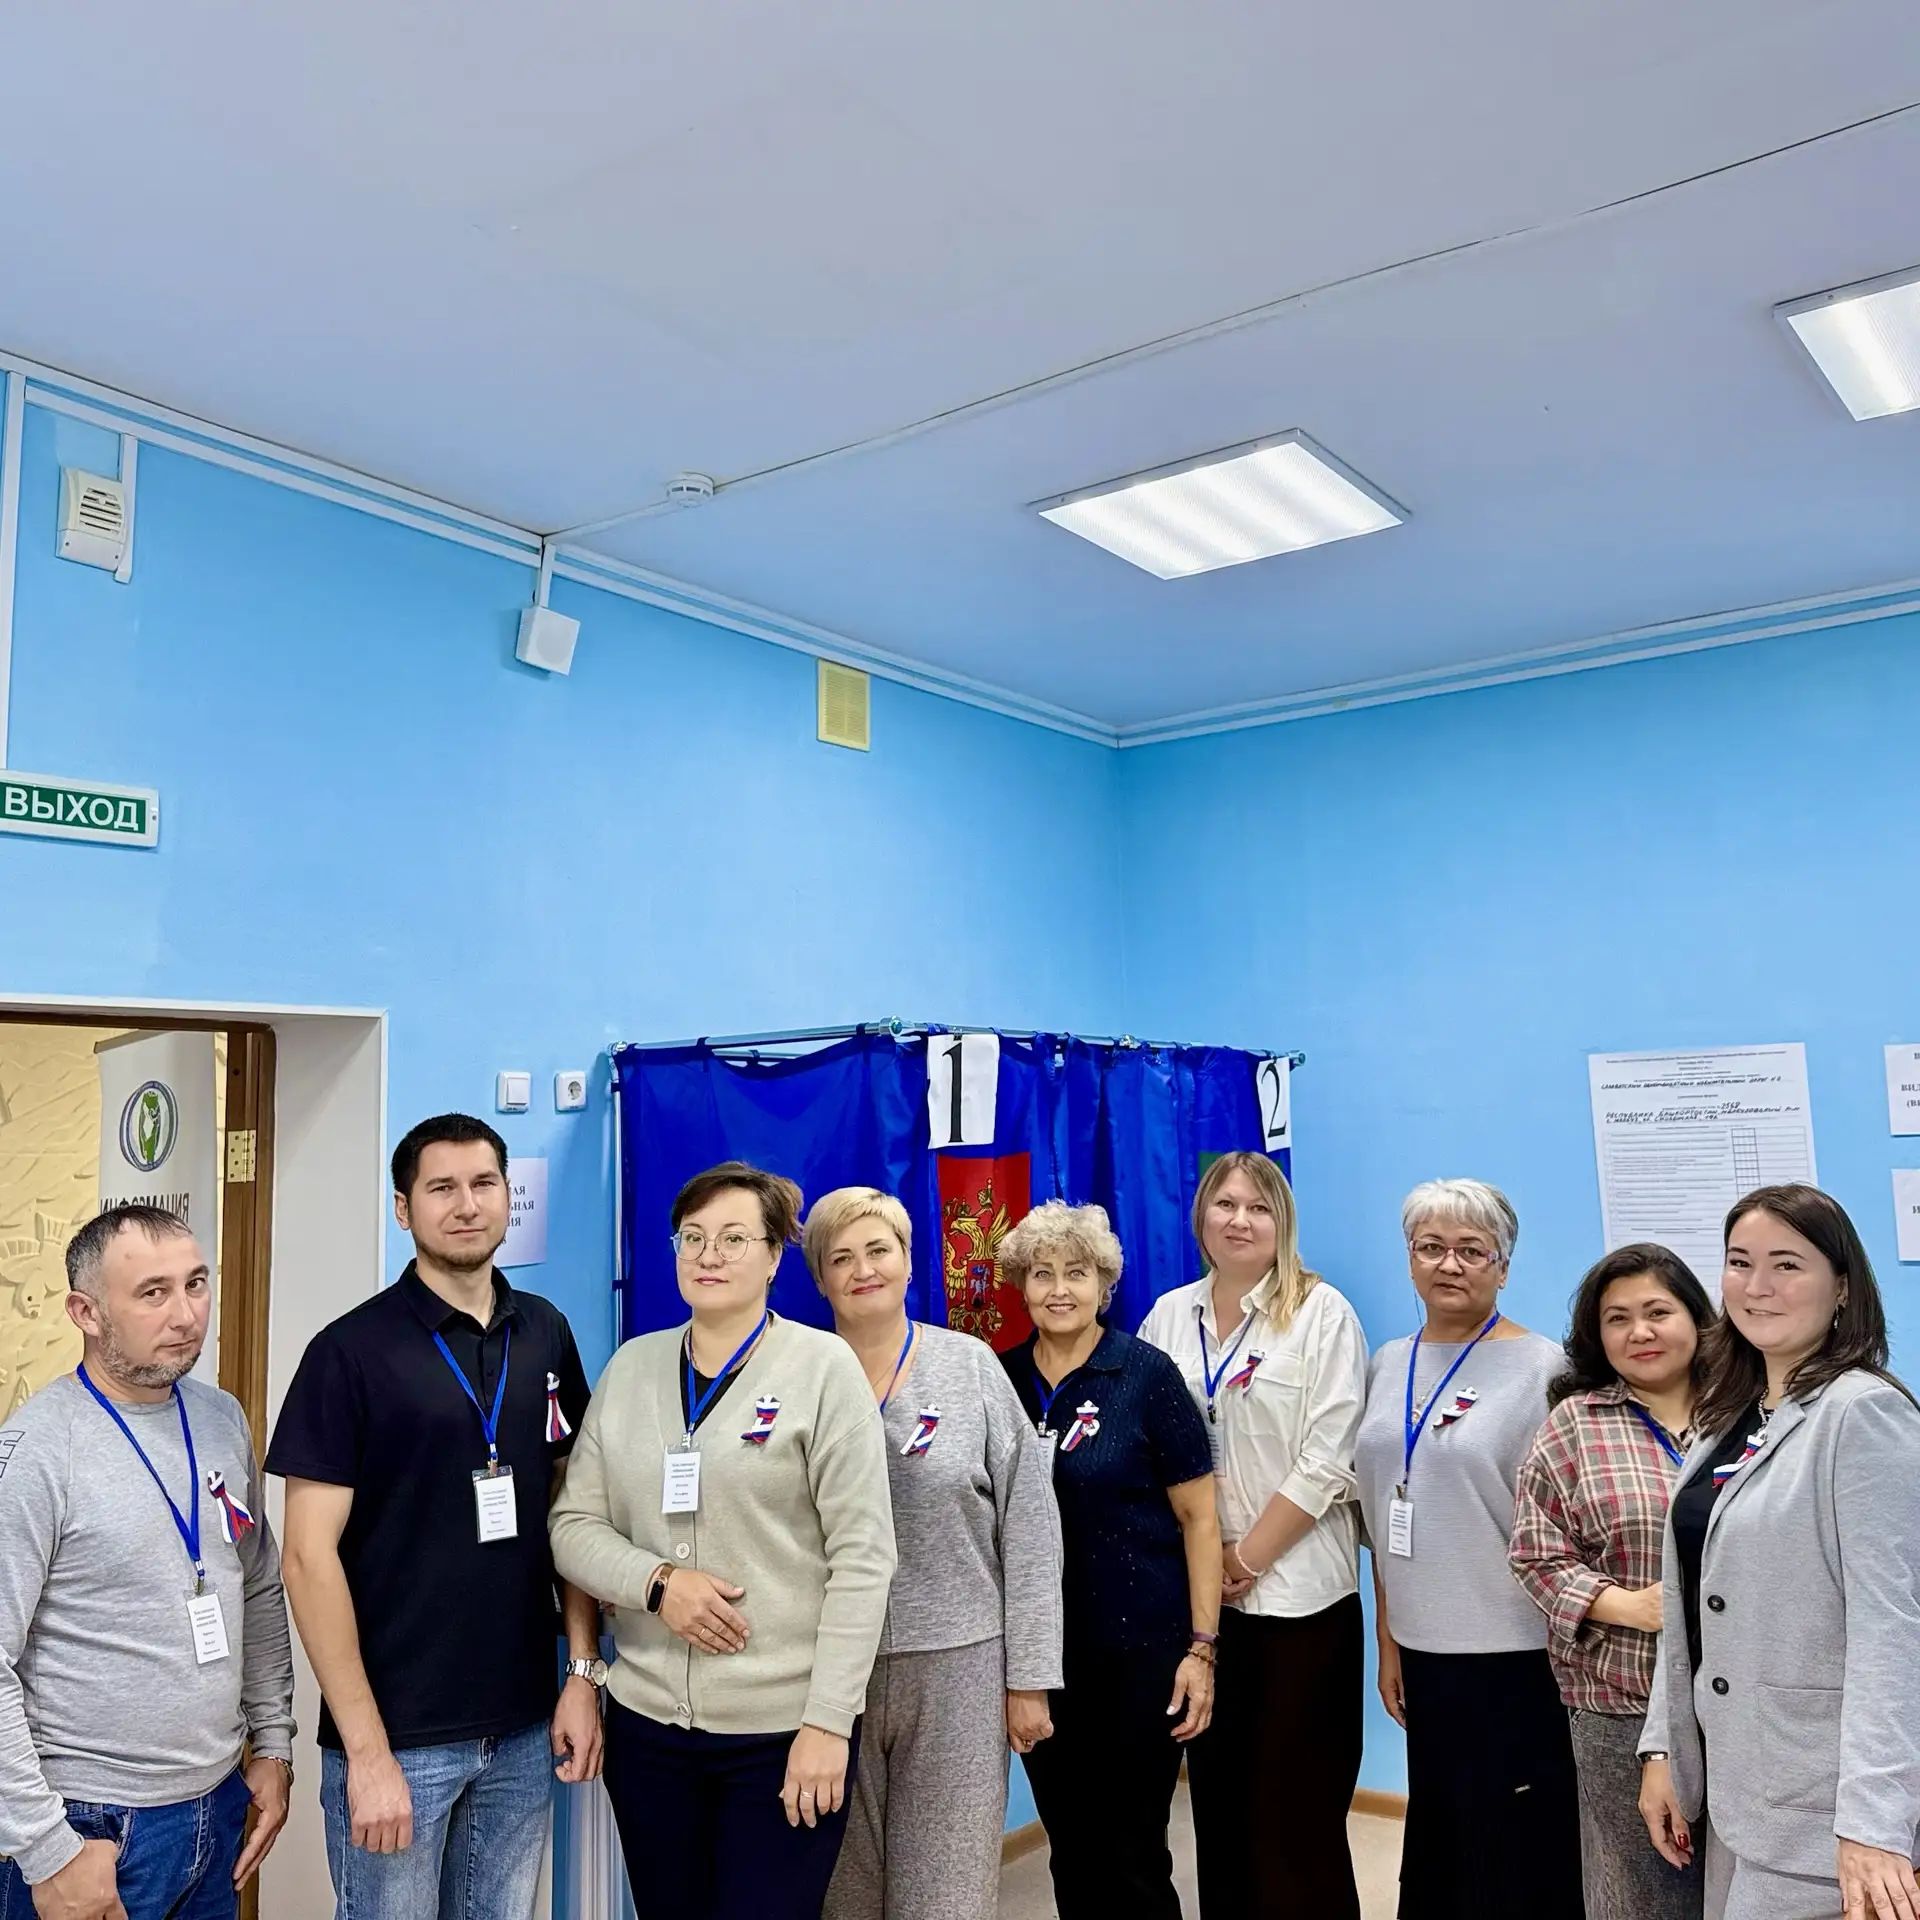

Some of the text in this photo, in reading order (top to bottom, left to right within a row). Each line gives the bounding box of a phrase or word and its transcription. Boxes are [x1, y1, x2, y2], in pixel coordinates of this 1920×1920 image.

[5, 786, 139, 831] ВЫХОД
[942, 1042, 965, 1143] 1
[1261, 1063, 1287, 1138] 2
